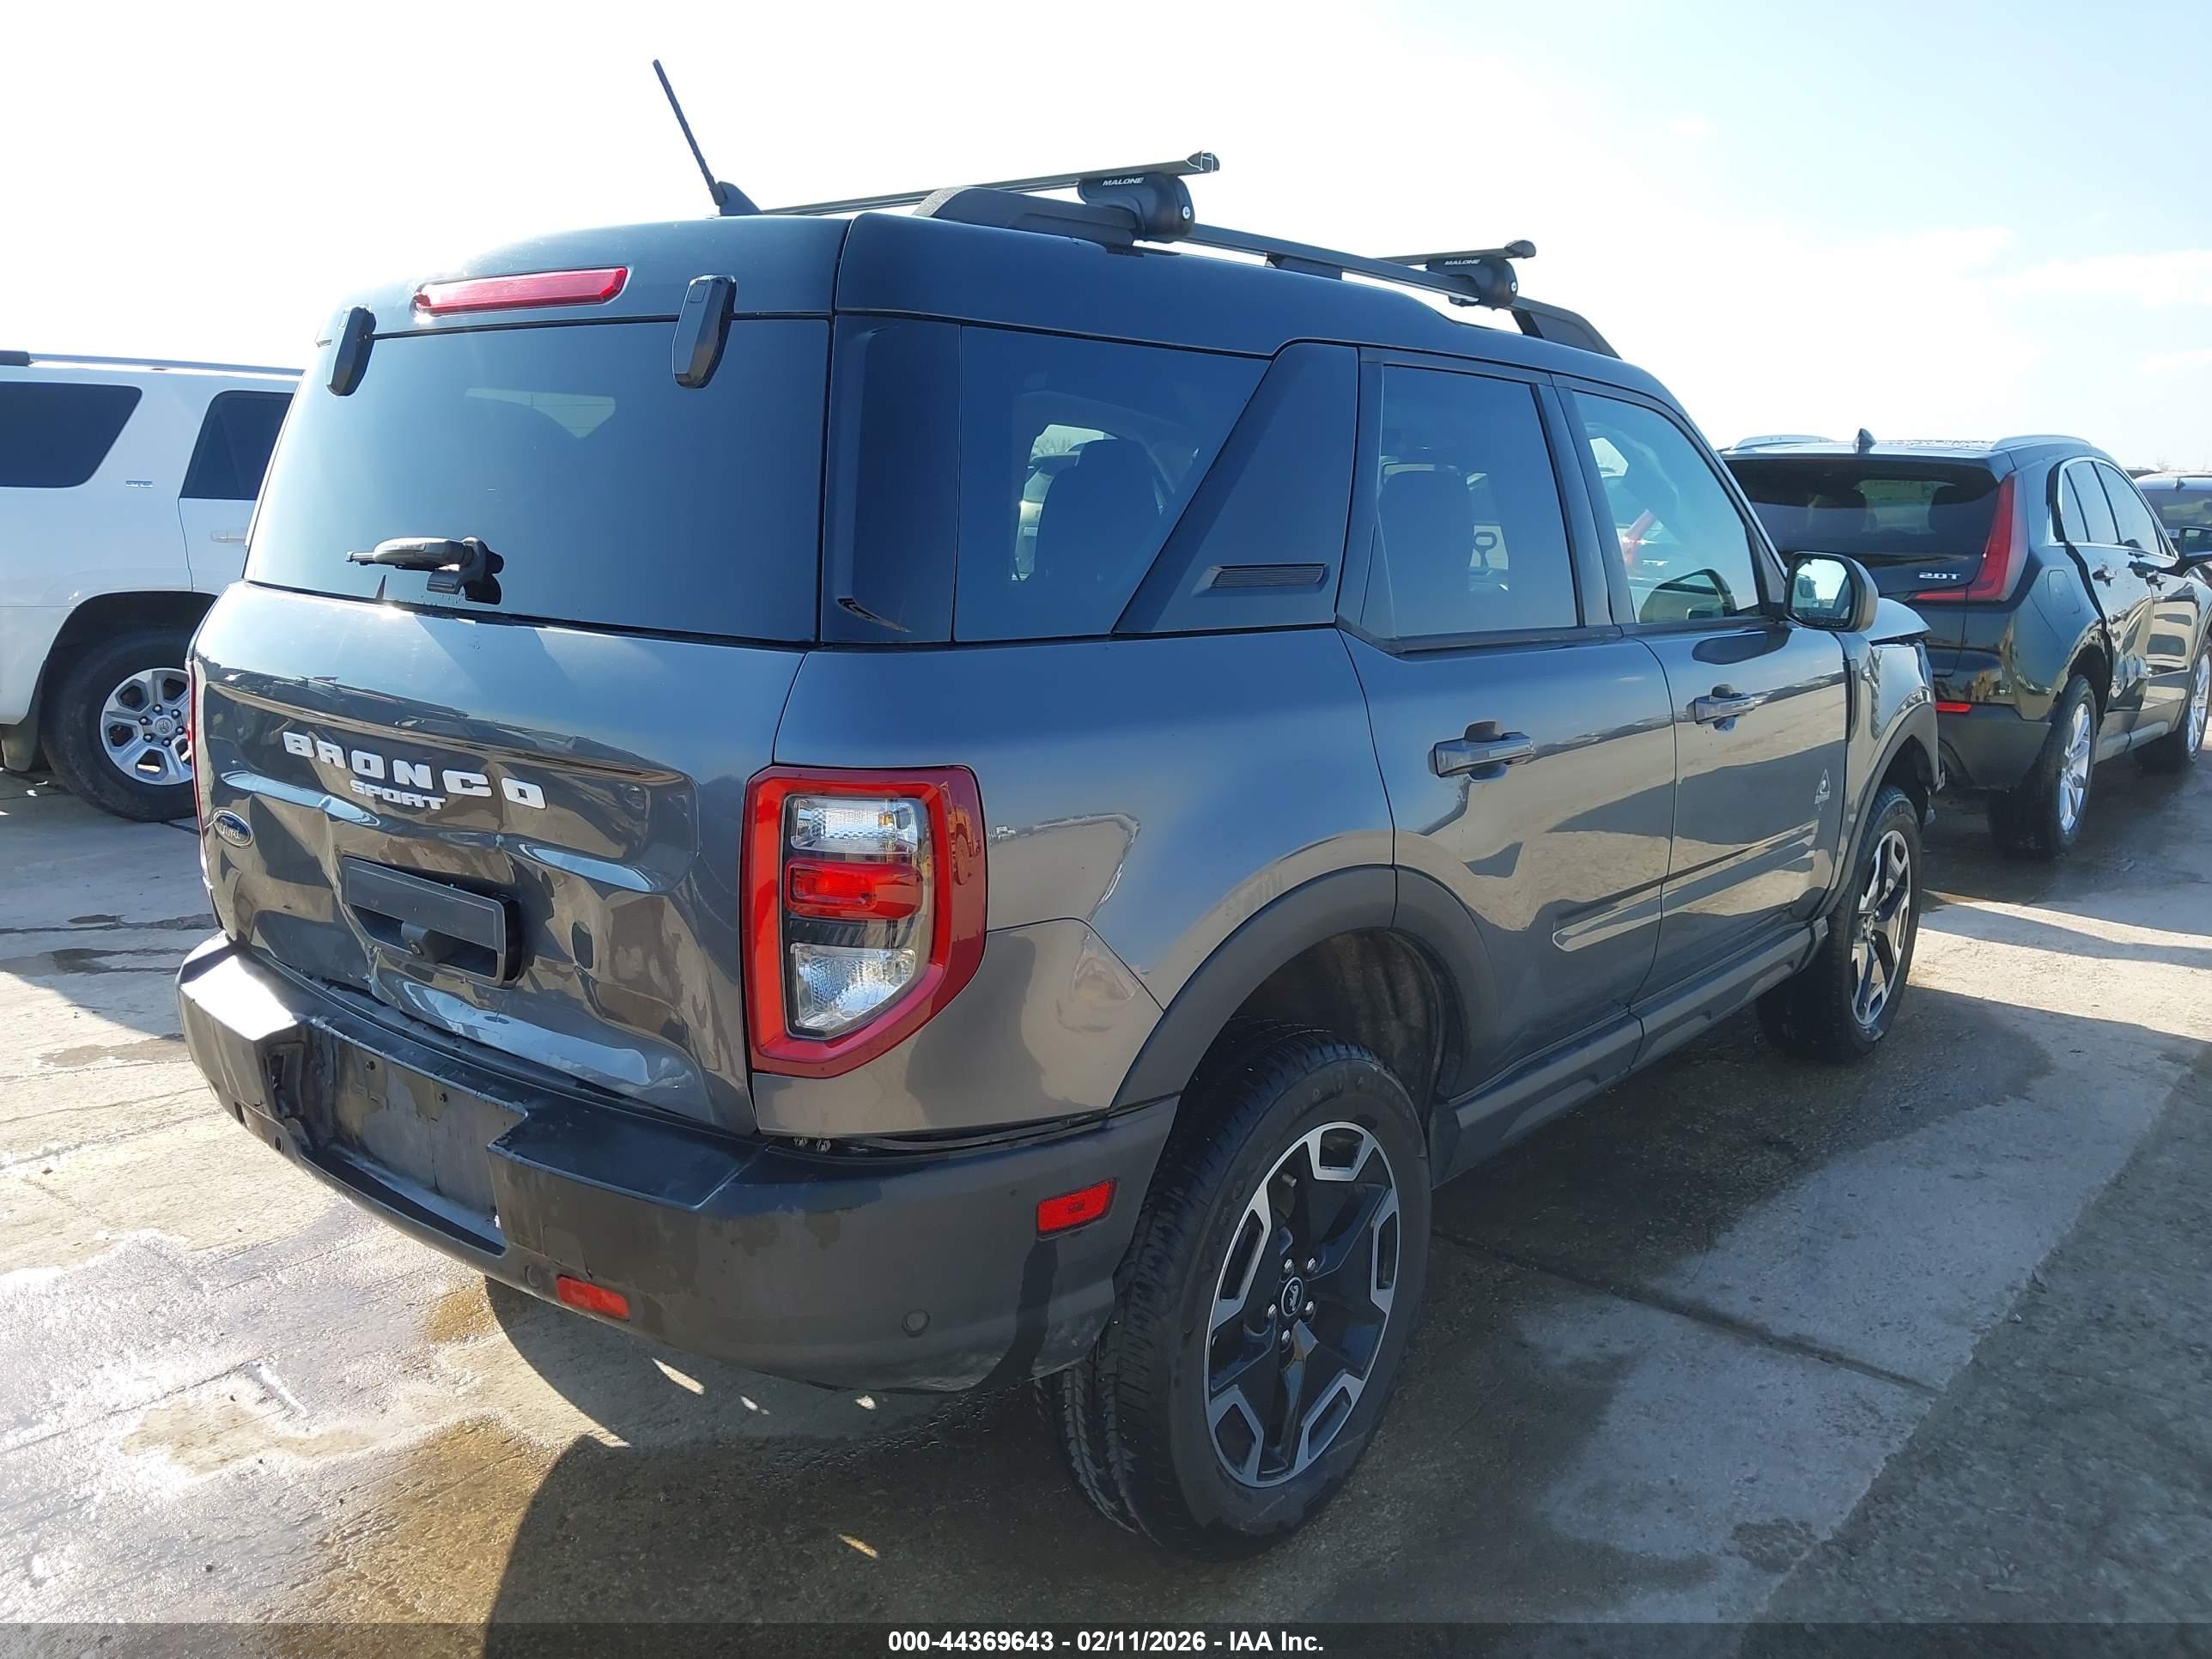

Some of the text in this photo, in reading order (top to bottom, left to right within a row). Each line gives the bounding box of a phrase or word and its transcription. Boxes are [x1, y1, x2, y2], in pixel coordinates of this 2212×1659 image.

[1103, 177, 1144, 186] MALONE
[283, 731, 546, 810] BRONCO
[349, 779, 447, 810] SPORT
